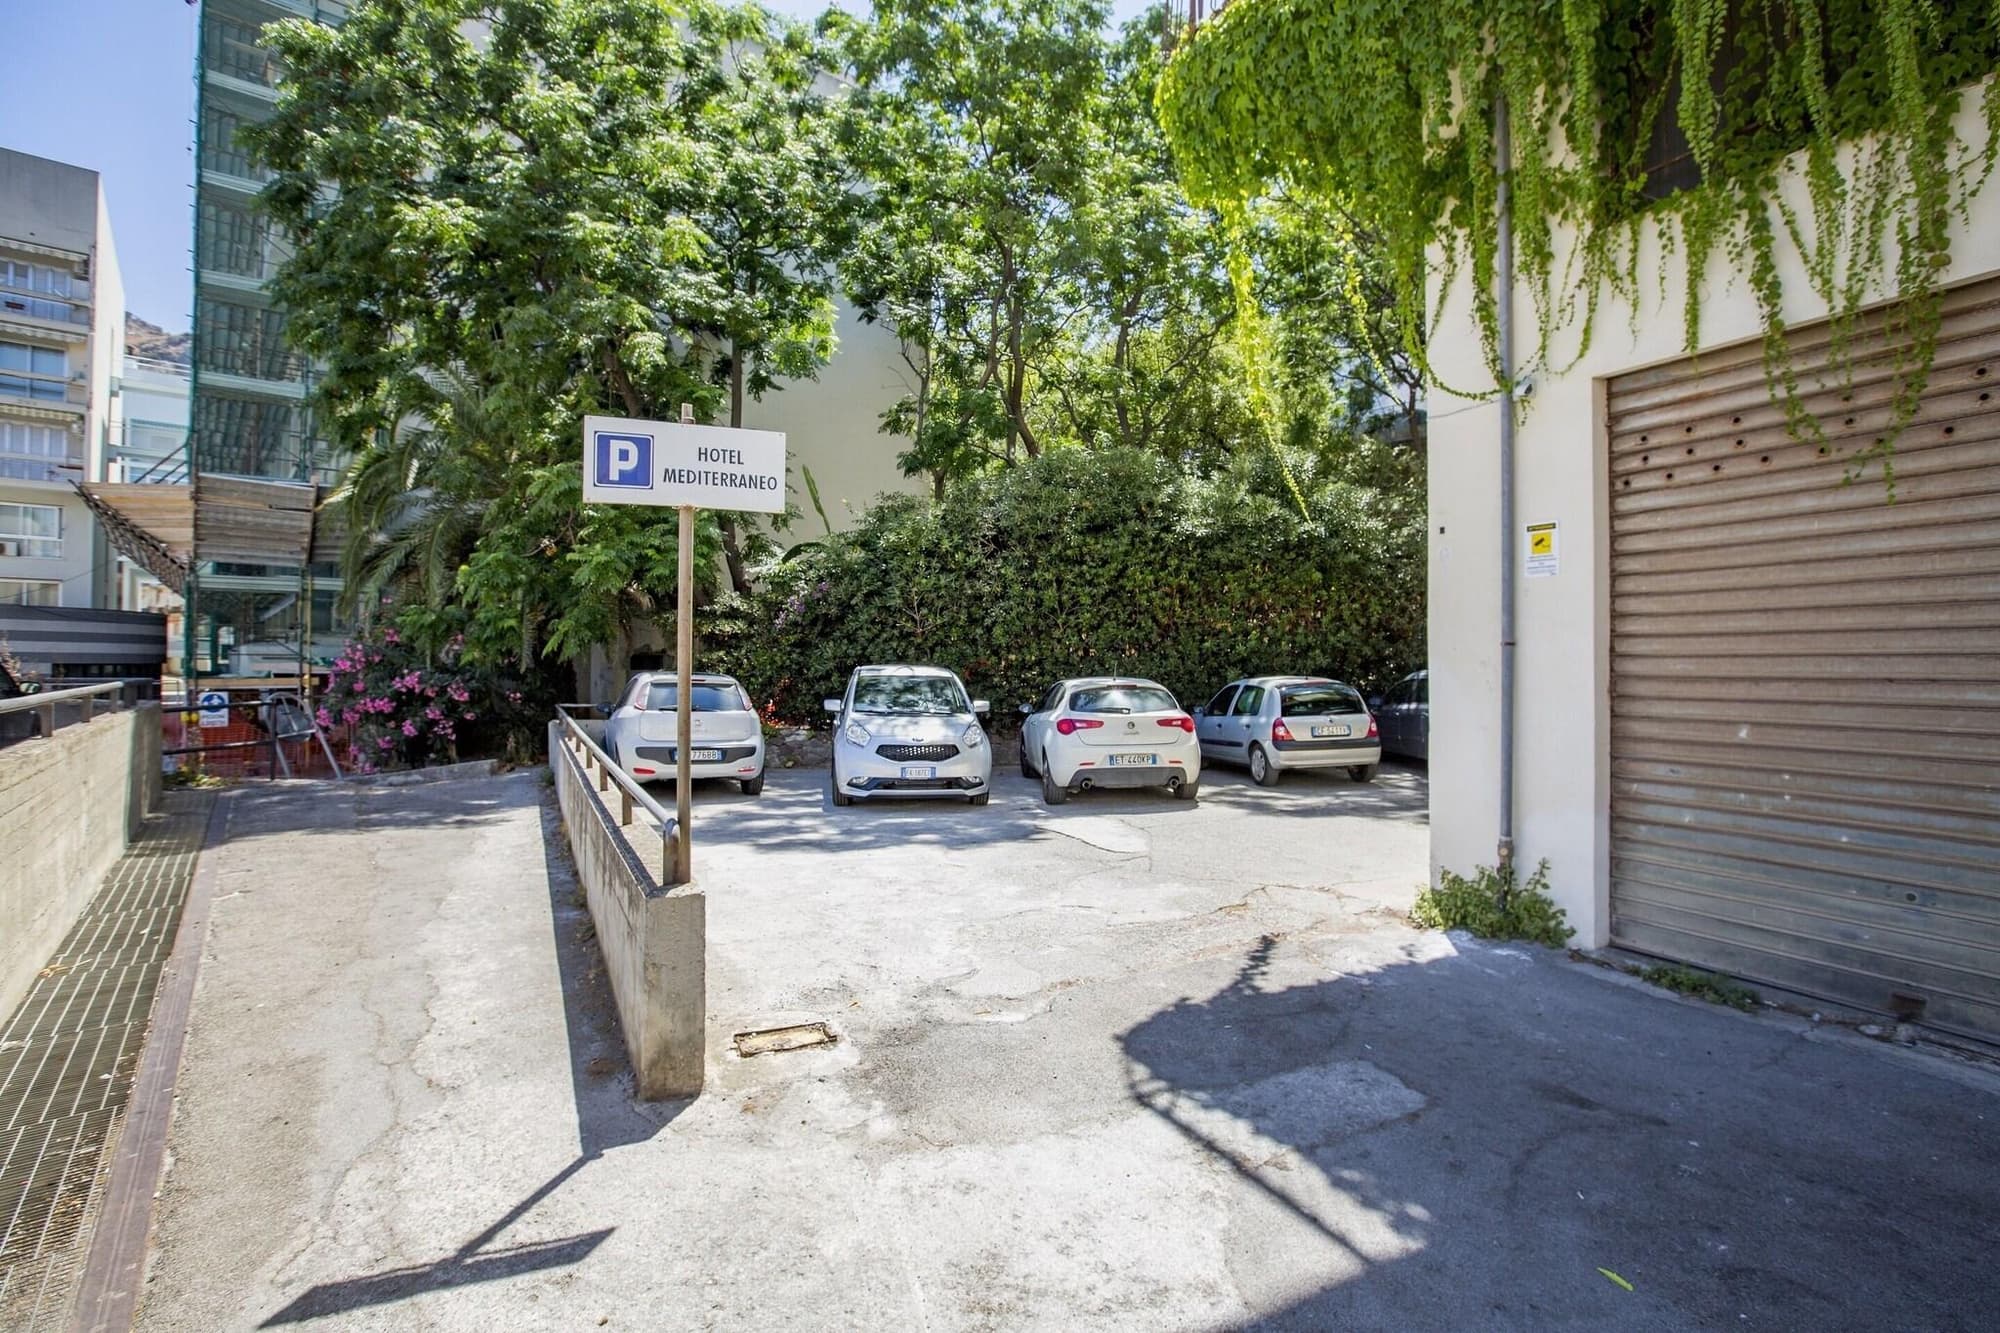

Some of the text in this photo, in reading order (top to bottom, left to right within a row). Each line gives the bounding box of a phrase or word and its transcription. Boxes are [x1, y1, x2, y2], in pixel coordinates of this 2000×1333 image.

[608, 439, 639, 481] P
[698, 447, 744, 465] HOTEL
[663, 468, 778, 491] MEDITERRANEO
